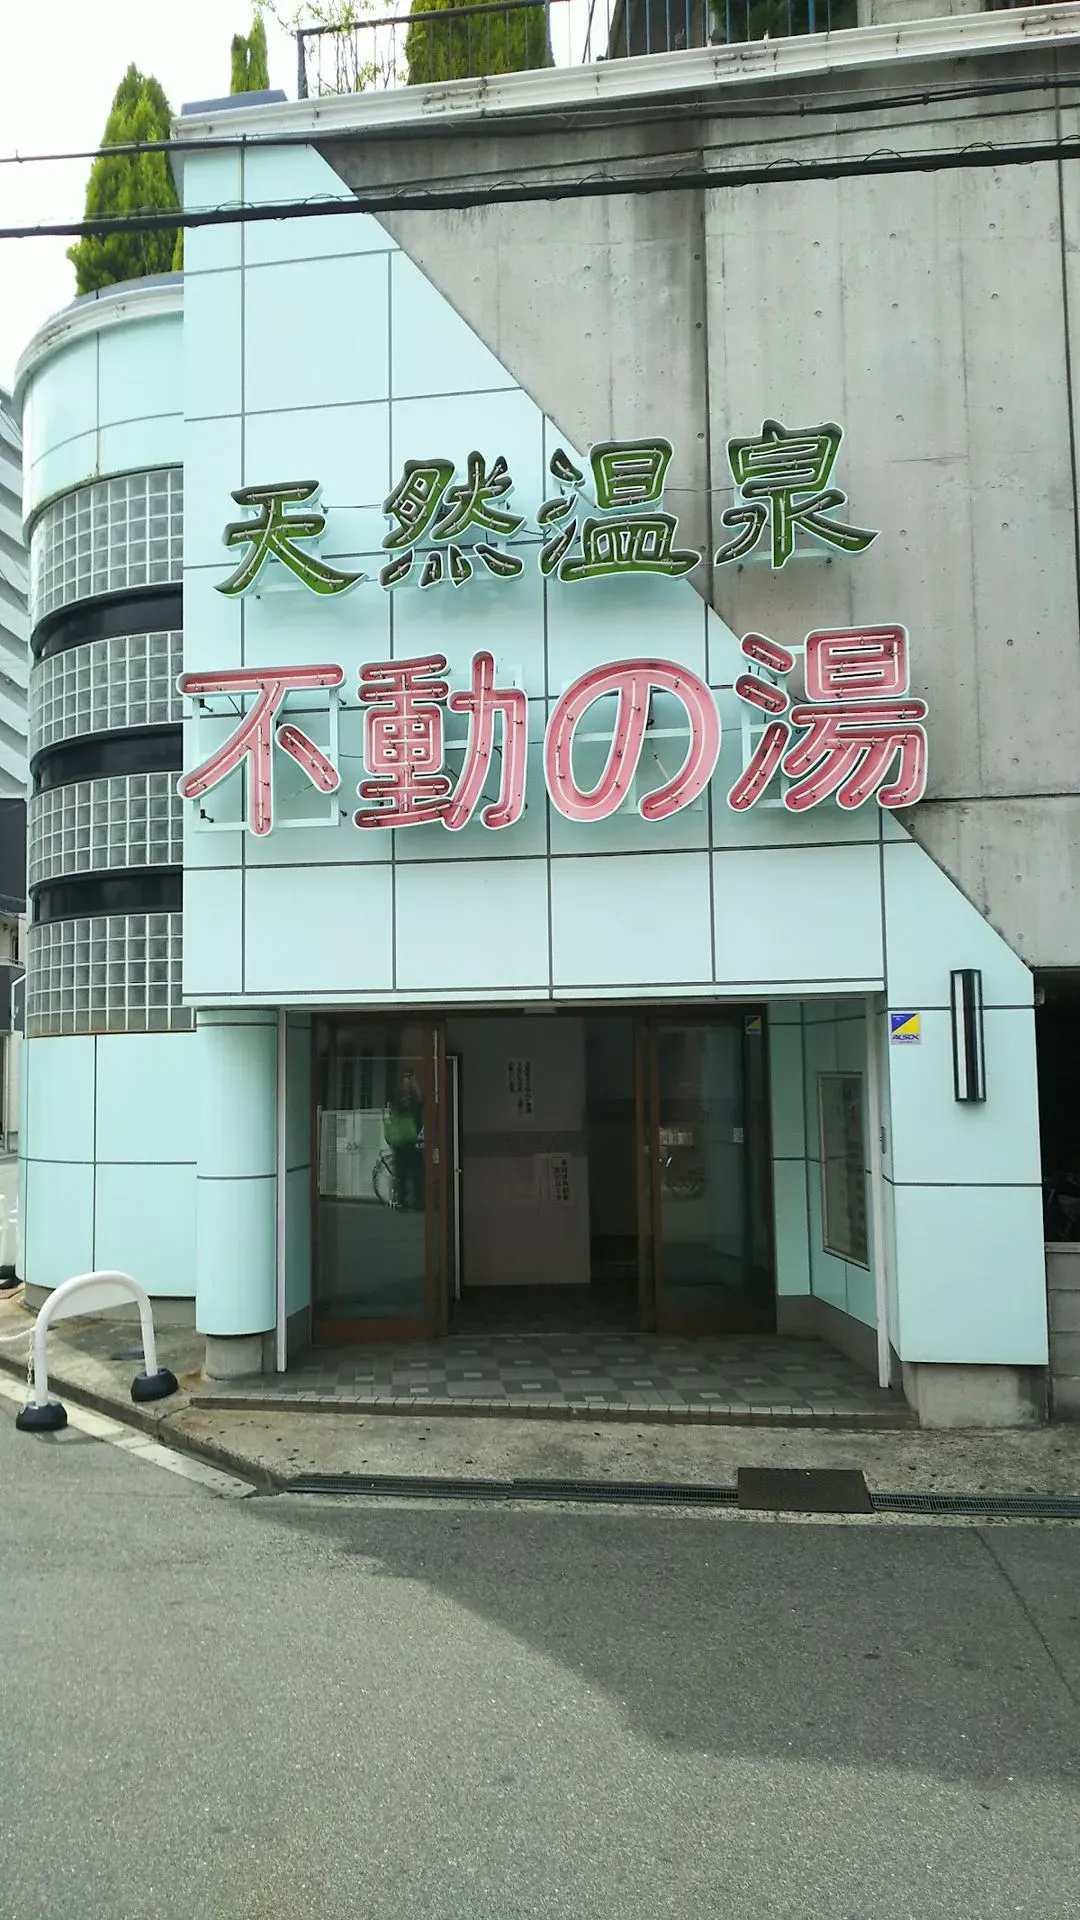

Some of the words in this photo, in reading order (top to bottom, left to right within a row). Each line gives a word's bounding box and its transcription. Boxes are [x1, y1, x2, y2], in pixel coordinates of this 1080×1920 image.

[212, 419, 881, 598] 天然温泉
[176, 622, 930, 838] 不動の湯
